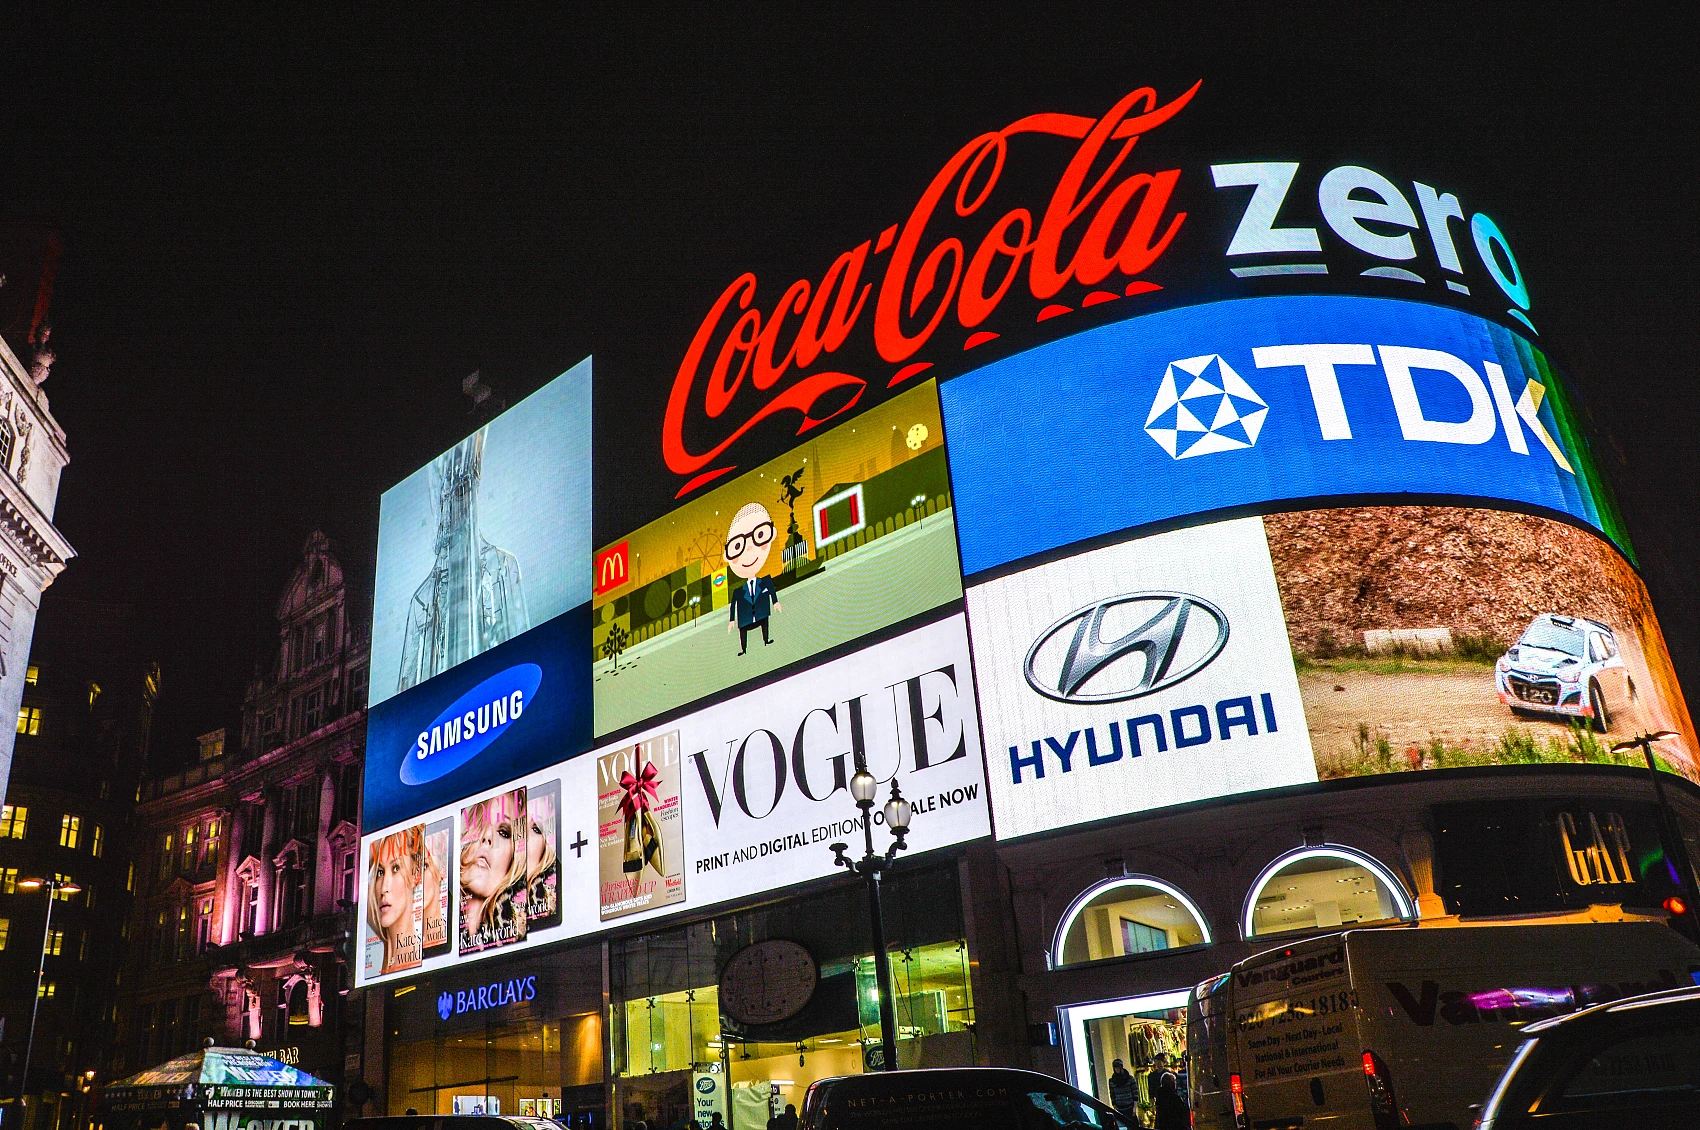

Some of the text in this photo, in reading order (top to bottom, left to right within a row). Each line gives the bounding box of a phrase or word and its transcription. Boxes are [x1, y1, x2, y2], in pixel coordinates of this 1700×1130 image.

[662, 78, 1531, 476] Coca-Cola zero
[1252, 343, 1576, 475] TDK
[416, 689, 524, 761] SAMSUNG
[1008, 692, 1278, 784] HYUNDAI
[598, 731, 679, 787] VOGUE
[688, 663, 967, 830] VOGUE
[462, 787, 526, 832] VOGUE
[695, 782, 979, 874] PRINT AND DIGITAL EDITION O ALE NOW
[370, 831, 425, 865] VOGUE
[1558, 811, 1637, 886] GAP
[396, 928, 422, 951] Kate's
[426, 926, 447, 943] world
[459, 926, 490, 951] Kate's
[492, 919, 520, 941] world
[396, 945, 422, 965] world
[1237, 946, 1345, 988] Vanguard
[1291, 967, 1345, 986] Couriers
[456, 975, 536, 1014] BARCLAYS
[1248, 1038, 1267, 1050] Same
[1267, 1036, 1281, 1048] Day
[1285, 1030, 1303, 1043] Next
[1303, 1029, 1317, 1041] Day
[1322, 1022, 1343, 1036] Local
[280, 1046, 300, 1065] BAR
[1255, 1039, 1340, 1064] National & International
[1254, 1055, 1346, 1079] For All Your Courier Needs
[207, 1100, 224, 1108] HALF
[224, 1099, 243, 1108] PRICE
[283, 1100, 300, 1108] BOOK
[300, 1100, 316, 1108] HERE
[245, 1090, 251, 1098] IS
[252, 1089, 263, 1098] THE
[263, 1089, 277, 1098] BEST
[277, 1090, 293, 1098] SHOW
[293, 1090, 301, 1098] IN
[696, 1097, 714, 1107] Your
[847, 1087, 1008, 1108] NET-A-PORTER.COM
[697, 1110, 713, 1118] new
